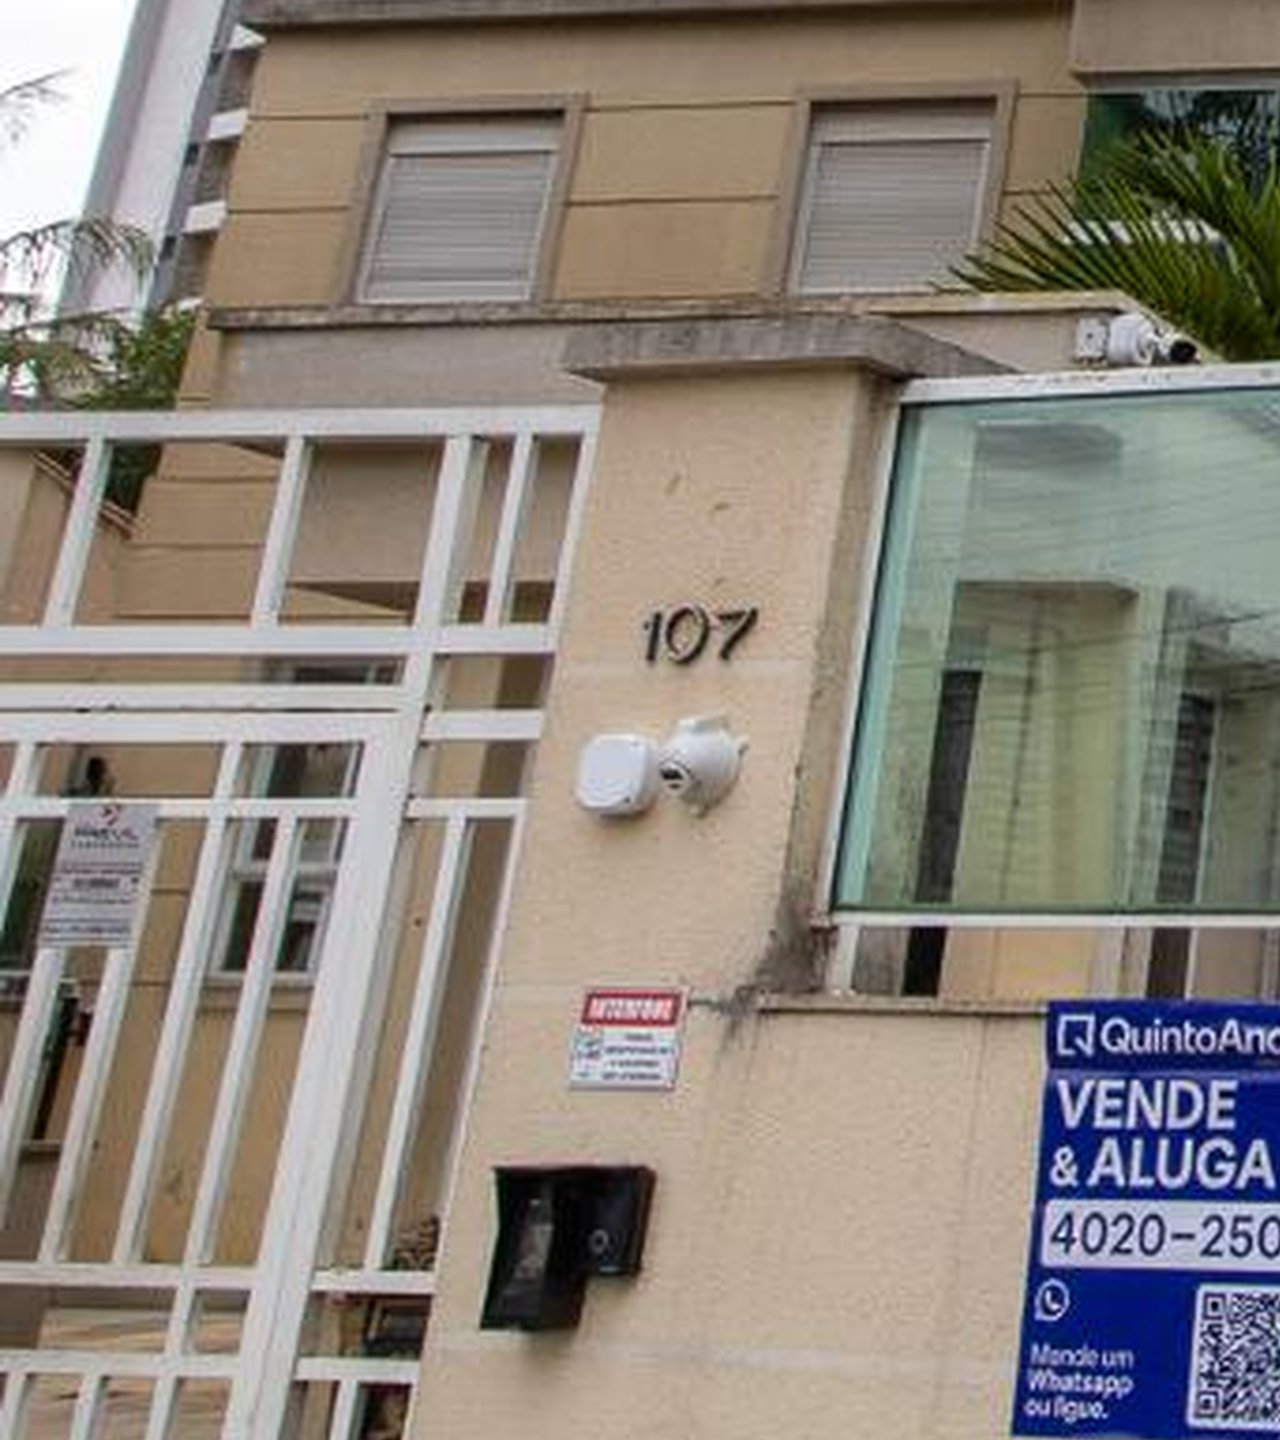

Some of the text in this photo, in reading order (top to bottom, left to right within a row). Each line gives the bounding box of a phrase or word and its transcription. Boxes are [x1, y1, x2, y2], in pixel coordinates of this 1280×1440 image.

[643, 606, 758, 665] 107
[1056, 1078, 1239, 1131] VENDE
[1050, 1137, 1277, 1190] & ALUGA
[1102, 1349, 1135, 1369] um
[1024, 1398, 1050, 1418] ou
